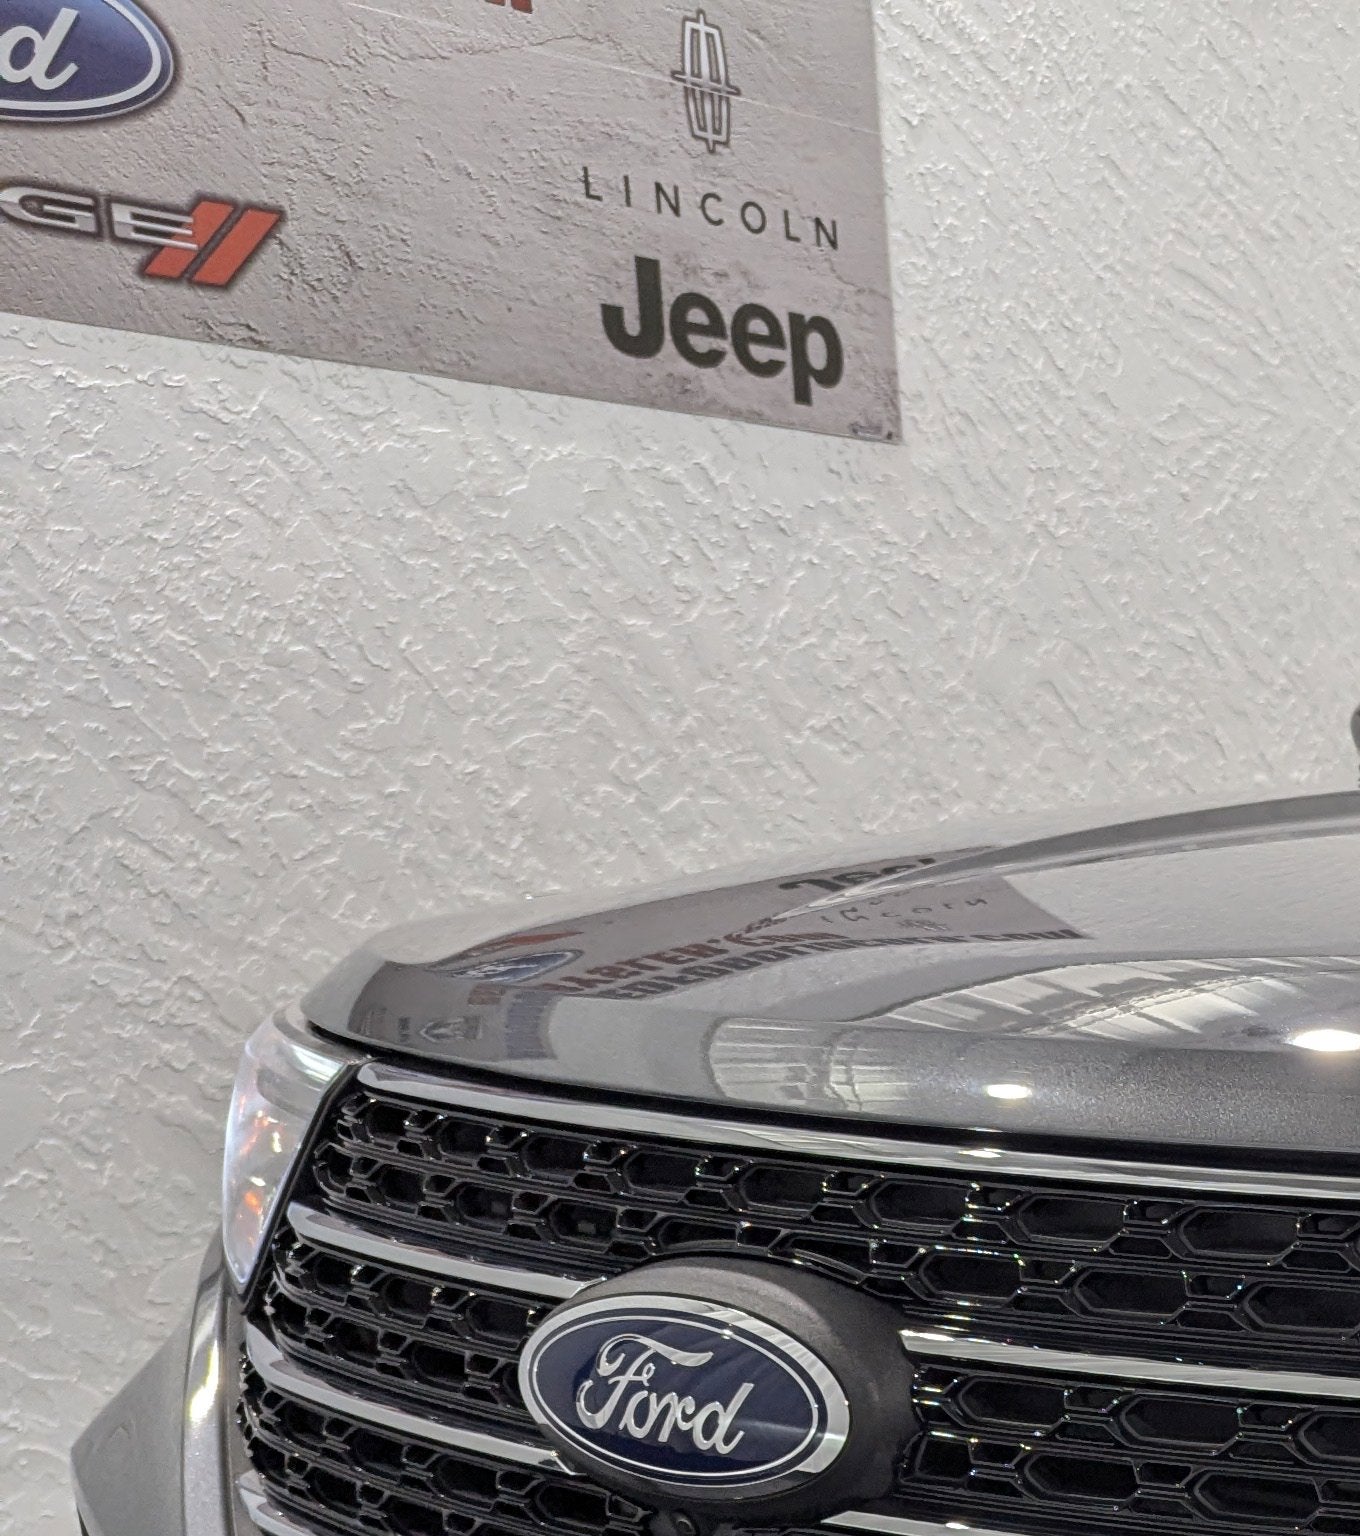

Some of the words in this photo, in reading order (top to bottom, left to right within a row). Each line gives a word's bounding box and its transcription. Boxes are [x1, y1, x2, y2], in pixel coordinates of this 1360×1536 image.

[583, 166, 838, 251] LINCOLN
[601, 255, 844, 407] Jeep
[575, 1332, 756, 1455] Ford
